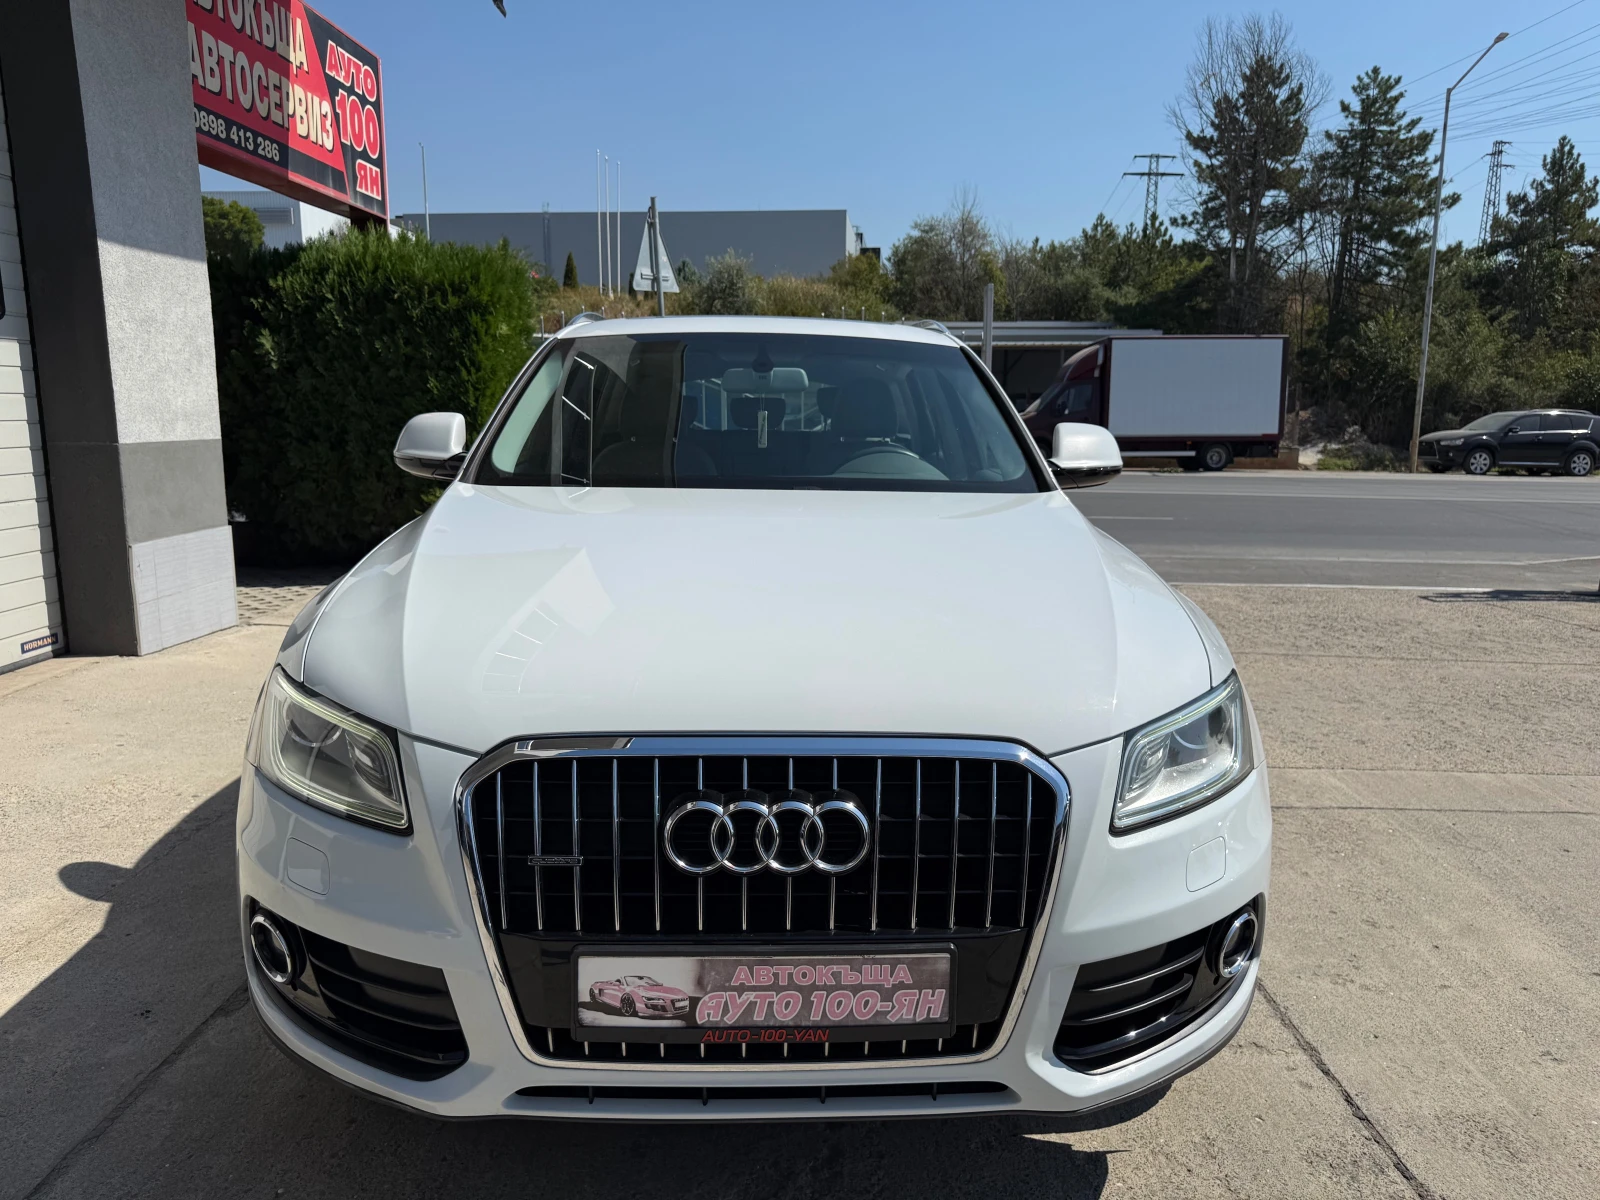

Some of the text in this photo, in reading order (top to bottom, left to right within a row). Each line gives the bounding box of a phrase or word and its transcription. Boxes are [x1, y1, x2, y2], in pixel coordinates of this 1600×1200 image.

[193, 0, 309, 76] ОКЪЩА
[187, 20, 334, 151] АВТОСЕРВИЗ
[325, 39, 377, 102] АУТО
[194, 106, 280, 162] 0898 413 286
[335, 88, 380, 159] 100
[355, 158, 381, 201] ЯН
[731, 964, 913, 988] АВТОКЪЩА
[696, 988, 946, 1025] АУТО 100-ЯН
[701, 1028, 830, 1043] AUTO-100-YAN
